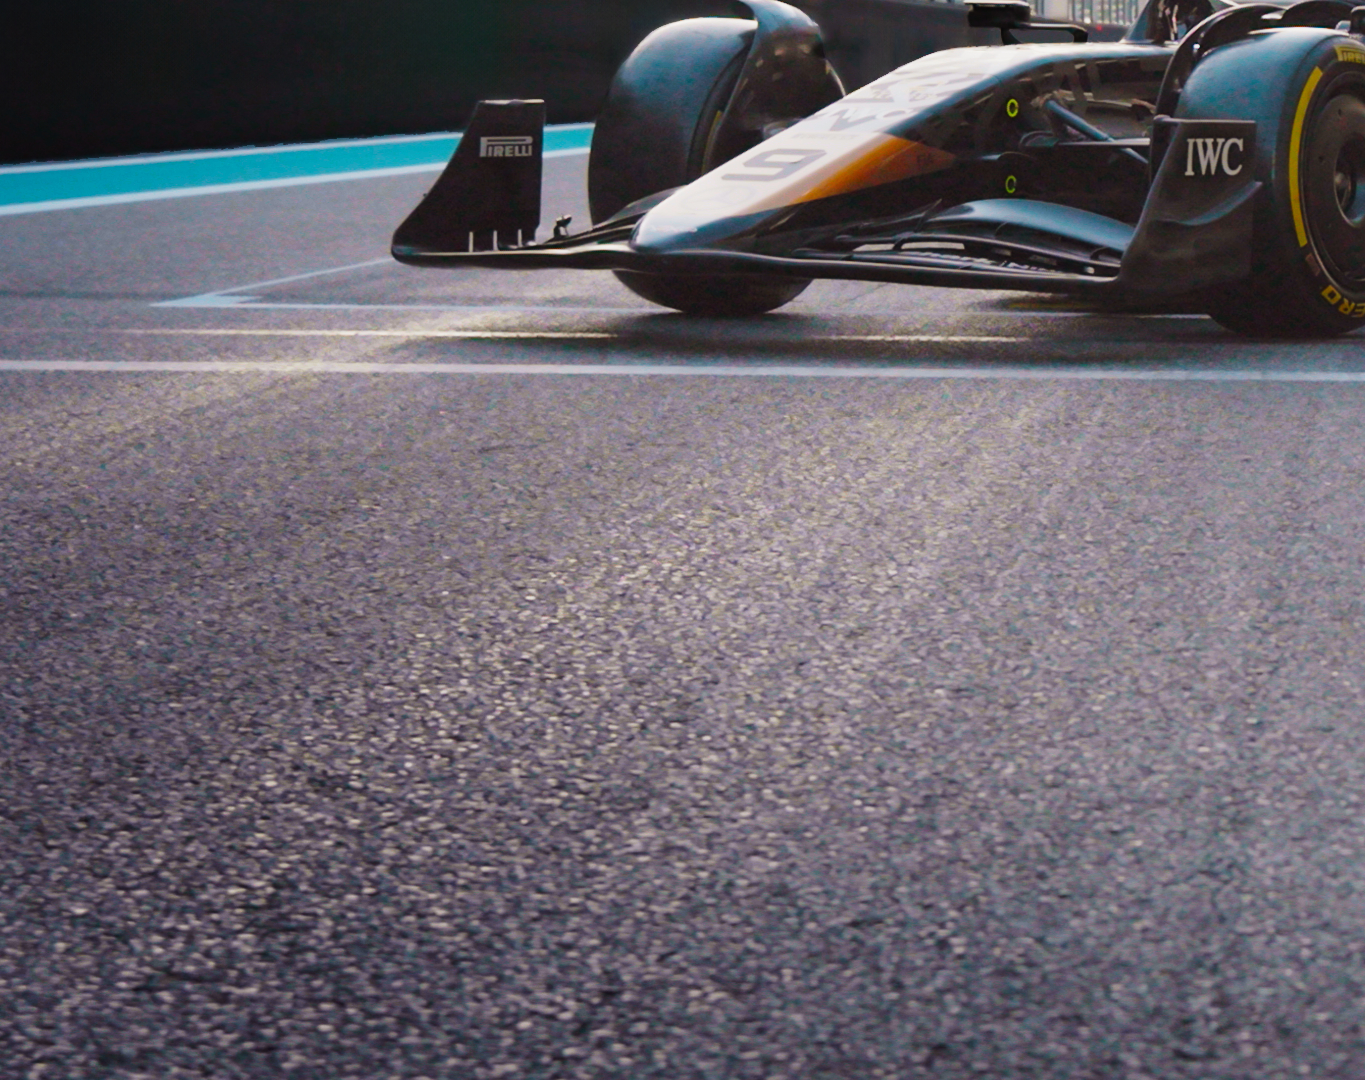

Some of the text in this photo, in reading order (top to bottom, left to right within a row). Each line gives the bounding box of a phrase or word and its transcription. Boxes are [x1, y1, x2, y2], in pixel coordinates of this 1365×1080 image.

[480, 136, 533, 157] PIRELLI
[1185, 138, 1243, 176] IWC
[721, 148, 827, 182] 9
